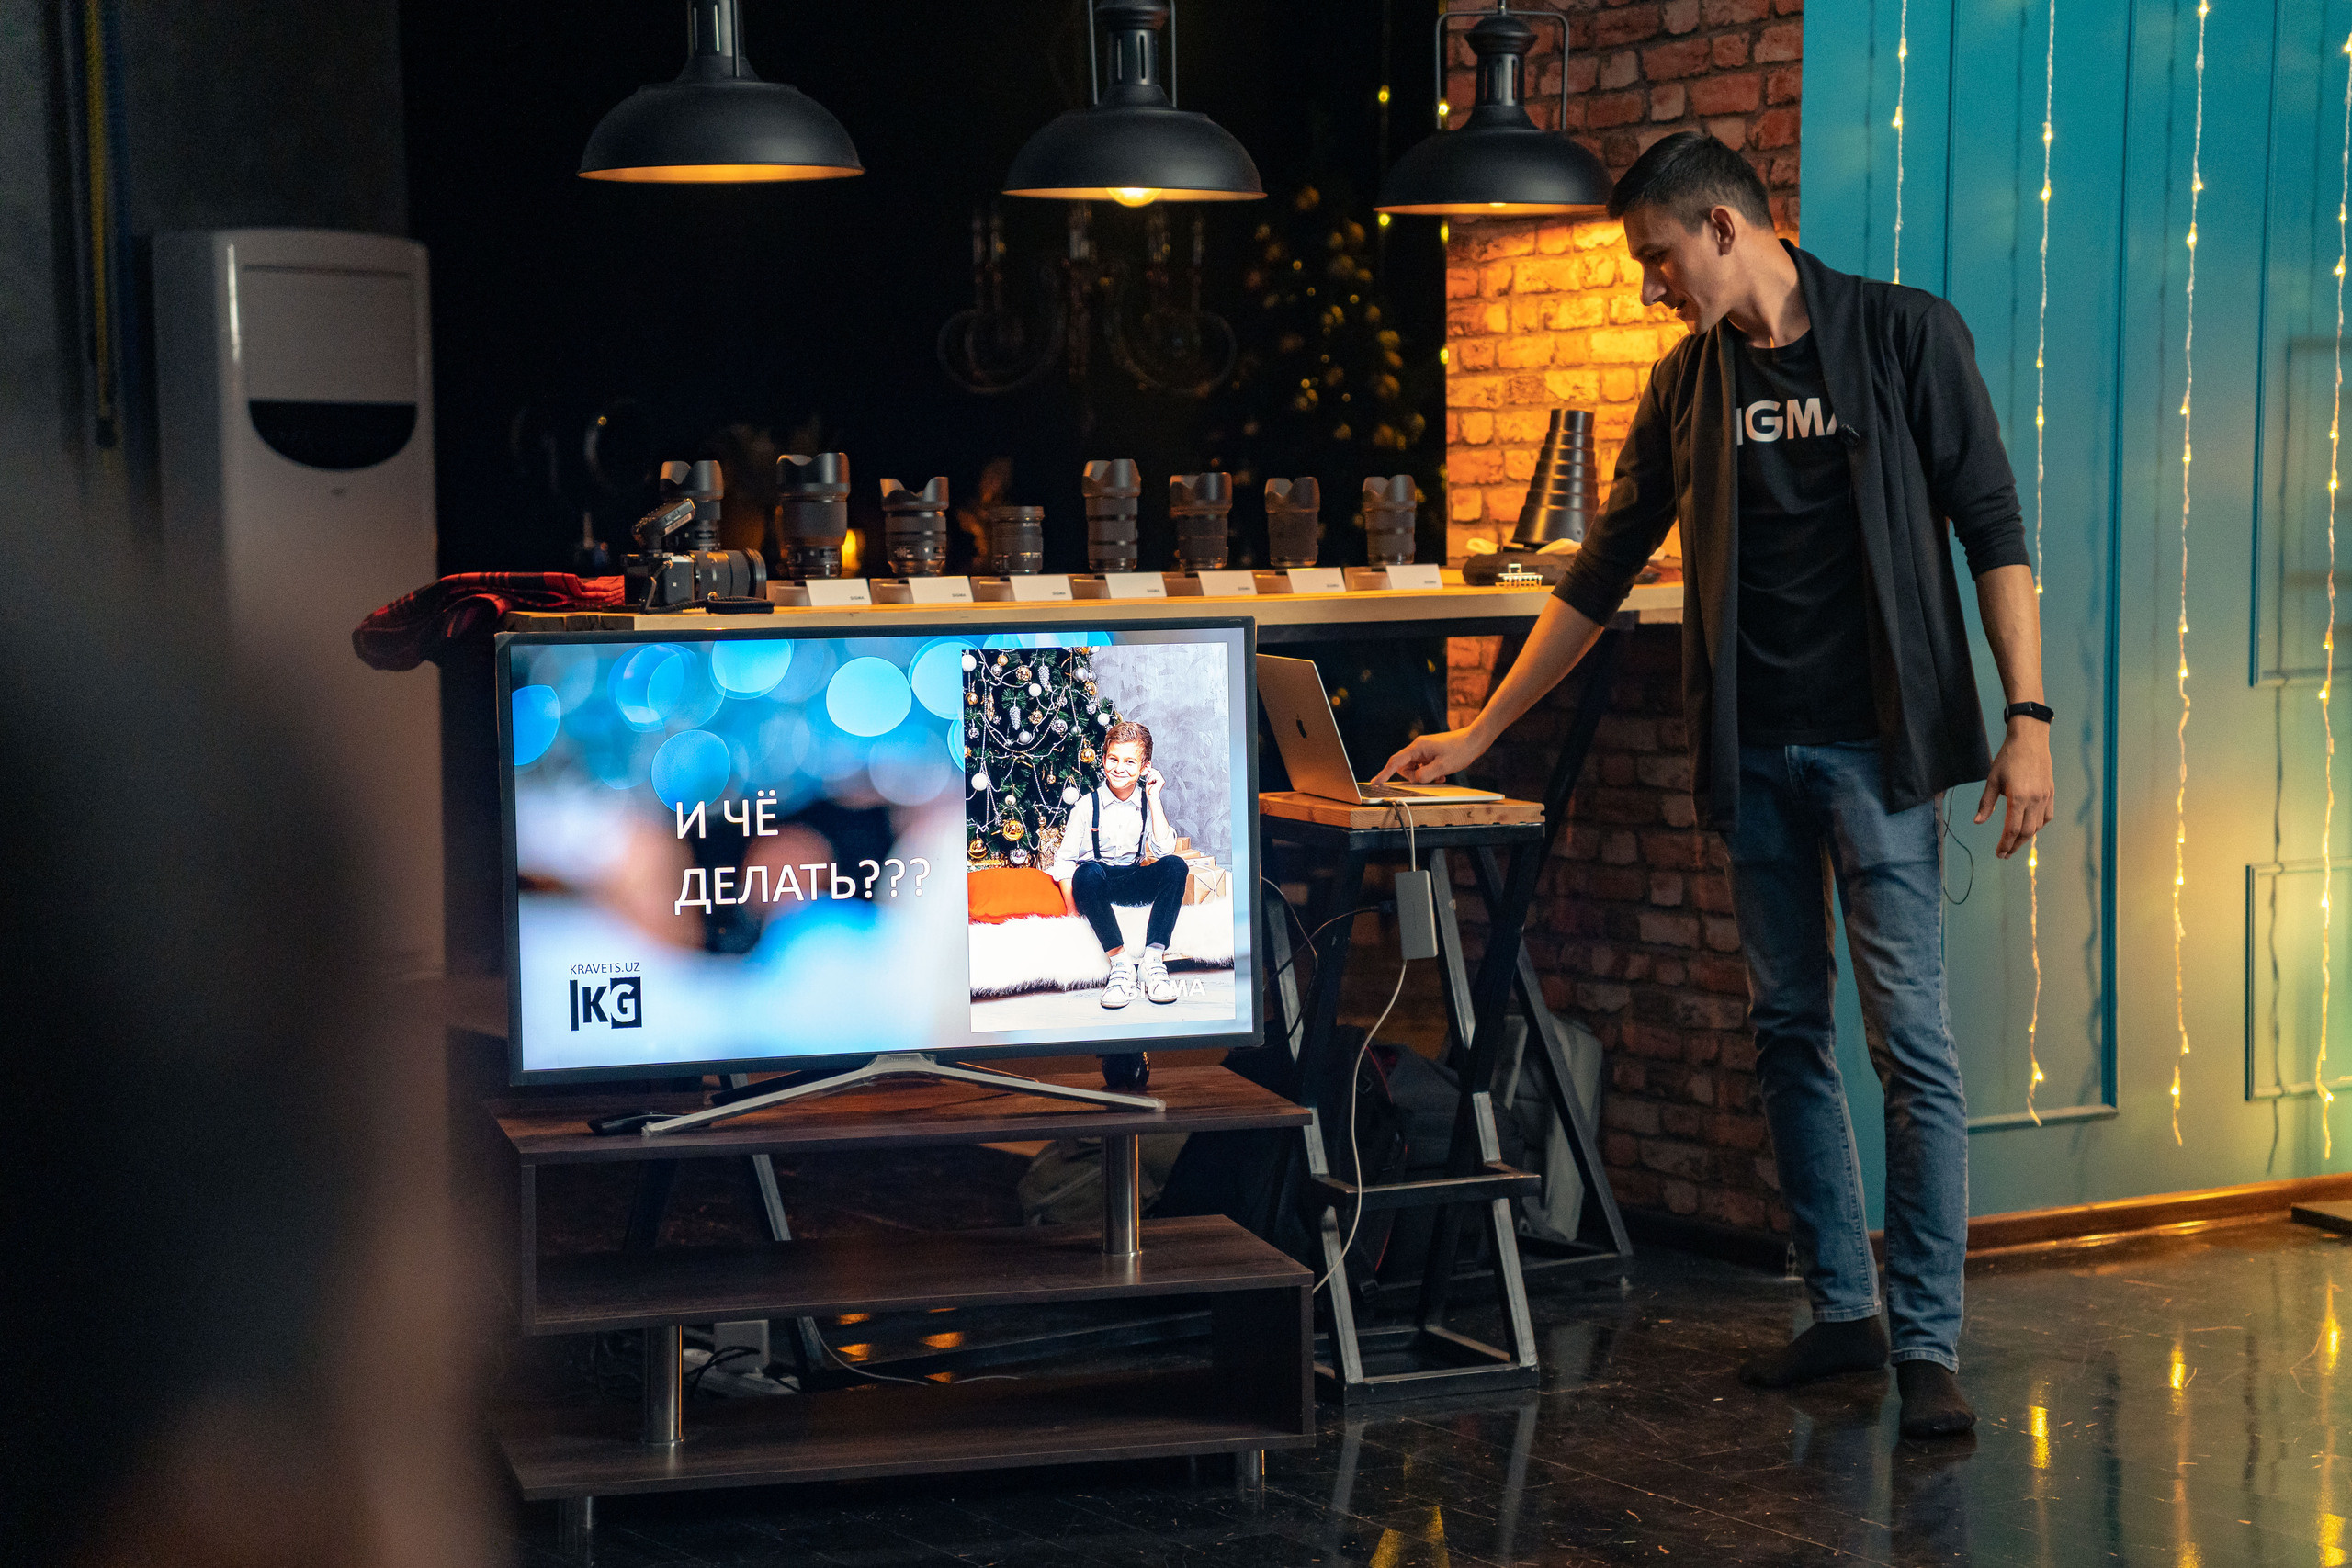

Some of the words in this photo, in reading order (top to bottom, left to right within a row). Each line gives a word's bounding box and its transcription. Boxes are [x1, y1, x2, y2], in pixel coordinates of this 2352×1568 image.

[676, 800, 707, 840] И
[723, 789, 779, 837] ЧЁ
[673, 857, 932, 916] ДЕЛАТЬ???
[570, 962, 640, 975] KRAVETS.UZ
